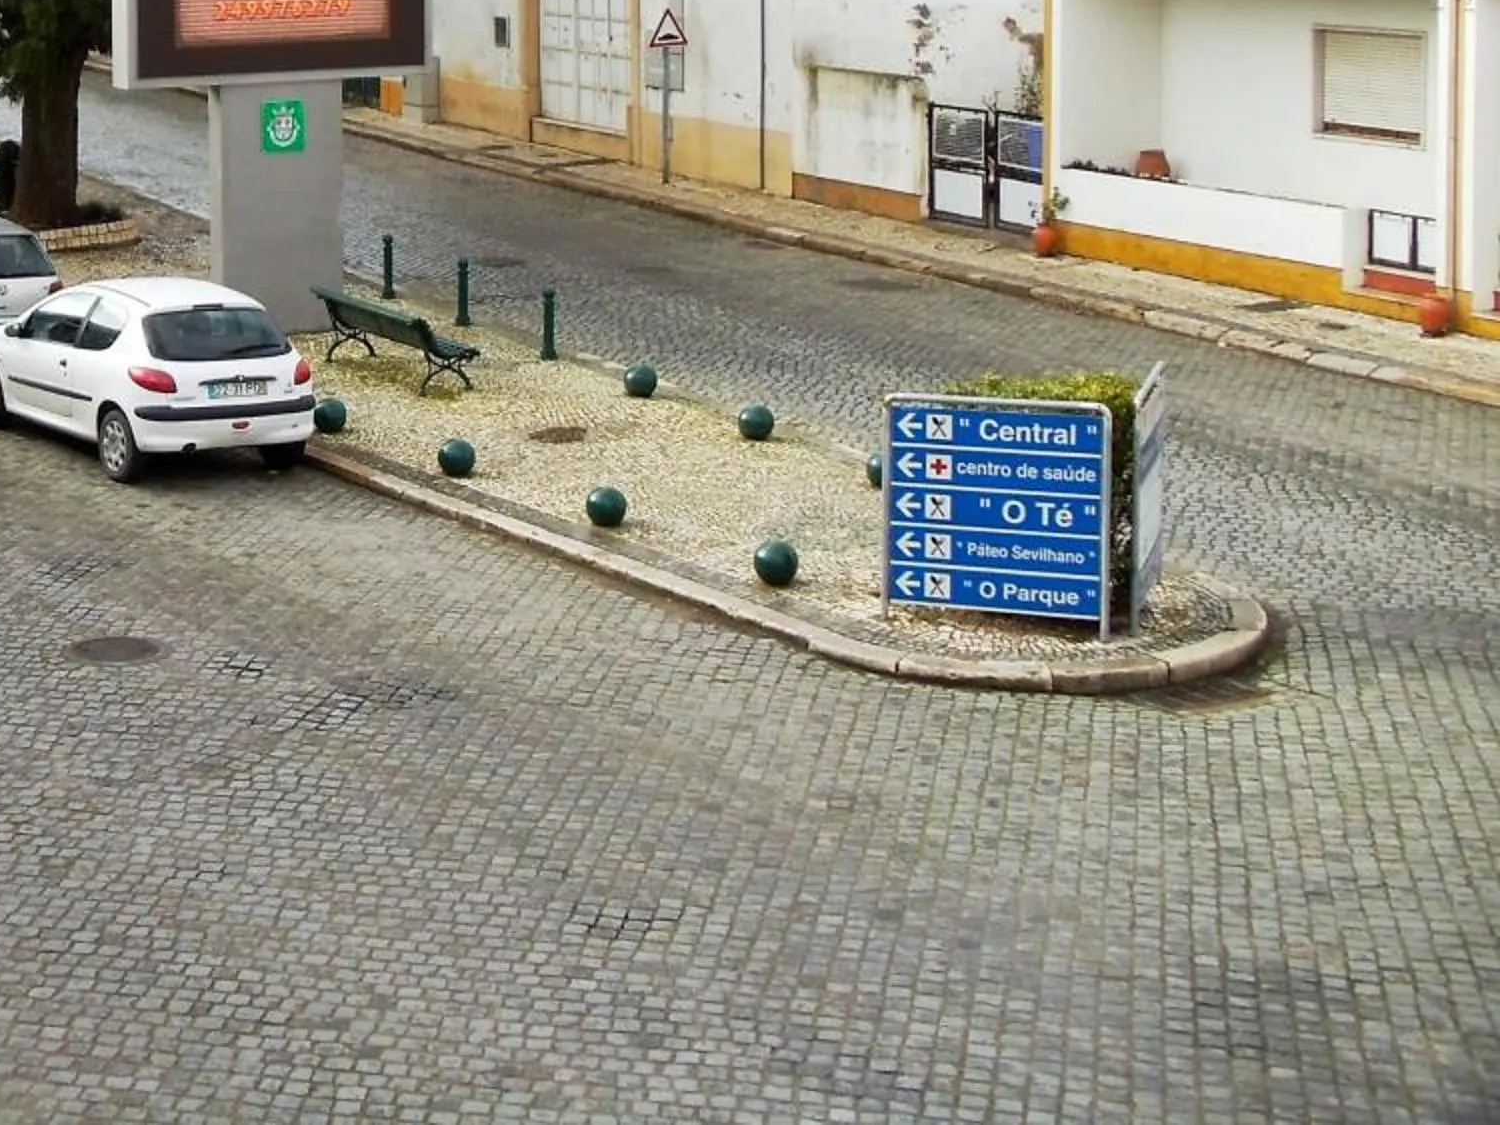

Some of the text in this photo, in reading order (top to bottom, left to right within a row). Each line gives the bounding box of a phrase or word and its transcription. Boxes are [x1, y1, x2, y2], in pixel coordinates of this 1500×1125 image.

[979, 418, 1077, 446] Central
[956, 461, 1097, 483] centro de saúde
[1001, 499, 1027, 525] O
[1035, 500, 1074, 528] Té
[1011, 544, 1086, 565] Sevilhano
[979, 580, 997, 599] O
[1003, 582, 1080, 608] Parque
